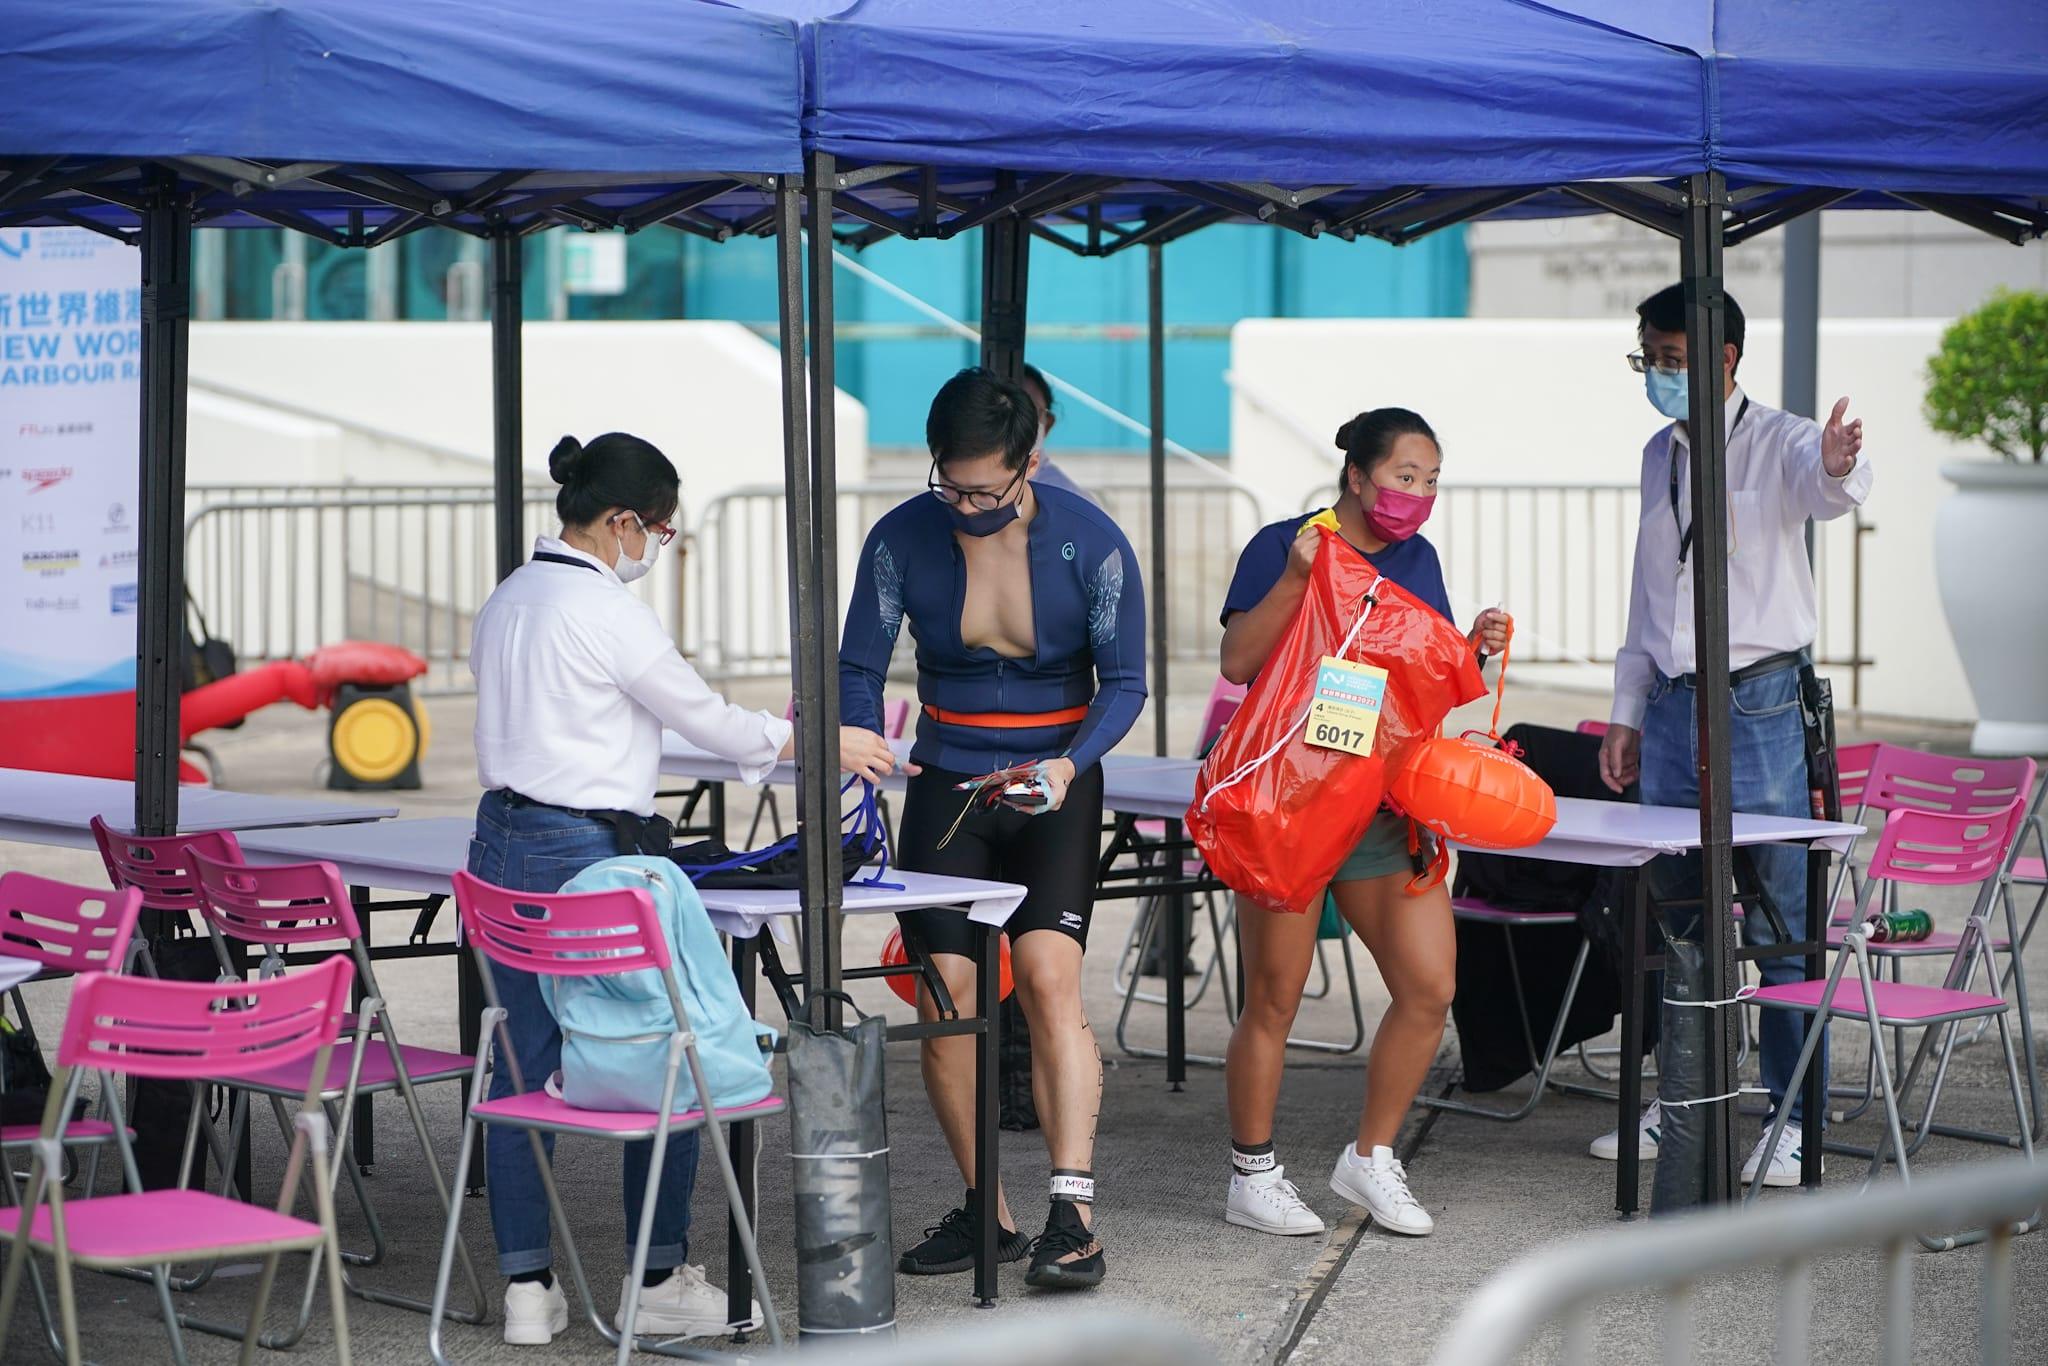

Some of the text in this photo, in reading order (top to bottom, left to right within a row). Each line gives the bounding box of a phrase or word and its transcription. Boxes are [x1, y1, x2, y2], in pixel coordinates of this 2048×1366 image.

[0, 330, 140, 360] EW WOR
[1, 363, 115, 386] ARBOUR
[1316, 703, 1324, 712] 4
[1316, 724, 1364, 749] 6017
[1233, 1152, 1271, 1165] MYLAPS
